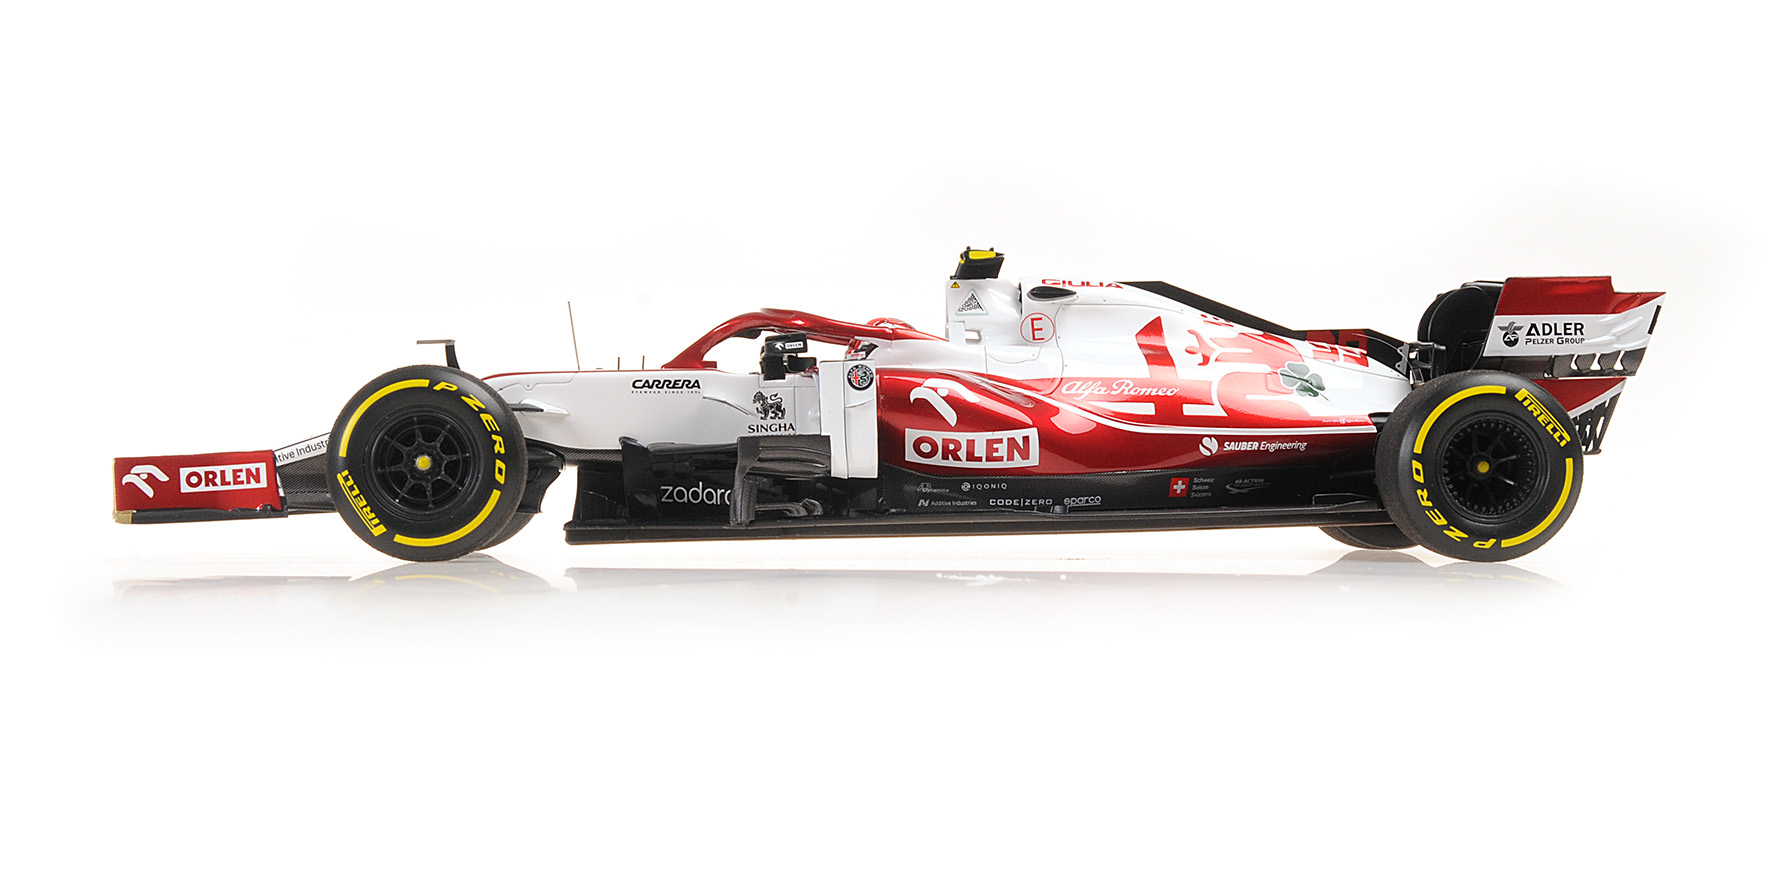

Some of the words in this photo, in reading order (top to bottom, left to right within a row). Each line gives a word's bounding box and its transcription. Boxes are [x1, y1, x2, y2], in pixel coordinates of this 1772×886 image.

[1041, 279, 1124, 289] GIULIA
[1030, 317, 1046, 342] E
[1525, 322, 1585, 337] ADLER
[1525, 338, 1555, 346] PELZER
[1556, 336, 1586, 346] GROUP
[632, 379, 701, 390] CARRERA
[1061, 380, 1110, 400] Alfa
[1110, 379, 1180, 397] Romeo
[1514, 387, 1572, 448] PIRELLI
[747, 422, 796, 434] SINGHA
[461, 393, 507, 485] ZERO
[1223, 441, 1260, 451] SAUBER
[1259, 440, 1308, 453] Engineering
[912, 434, 1031, 463] ORLEN
[185, 466, 262, 489] ORLEN
[972, 482, 1008, 491] IQONIQ
[336, 469, 388, 537] PIRELLI
[1063, 495, 1102, 506] sparco
[1411, 459, 1469, 542] ZERO
